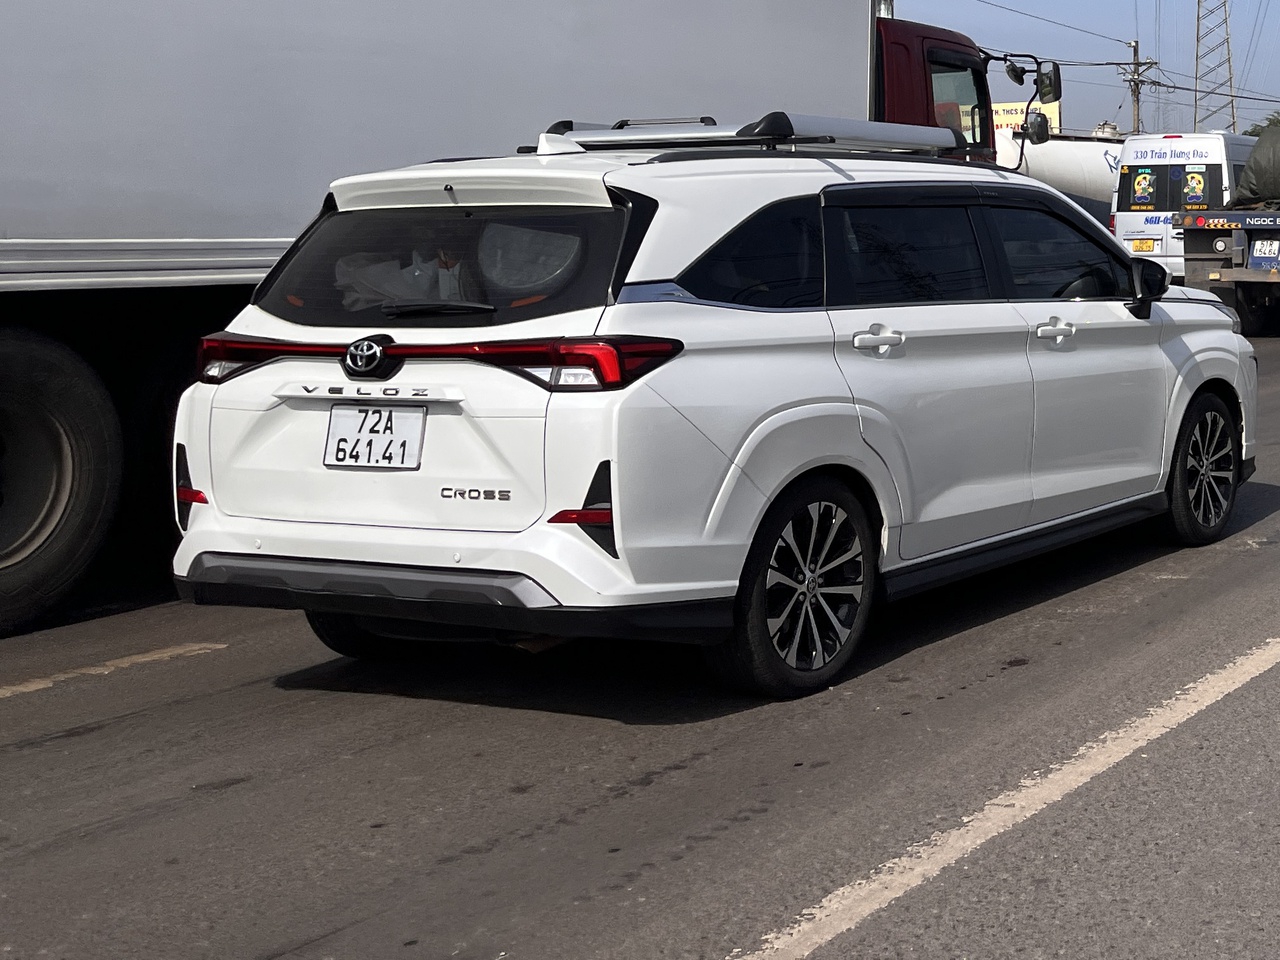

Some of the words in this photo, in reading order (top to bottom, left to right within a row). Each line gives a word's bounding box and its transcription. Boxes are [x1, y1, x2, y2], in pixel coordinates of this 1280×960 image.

[1134, 150, 1148, 159] 330
[301, 385, 429, 397] VELOZ
[357, 409, 394, 435] 72A
[335, 438, 407, 465] 641.41
[440, 487, 511, 501] CROSS
